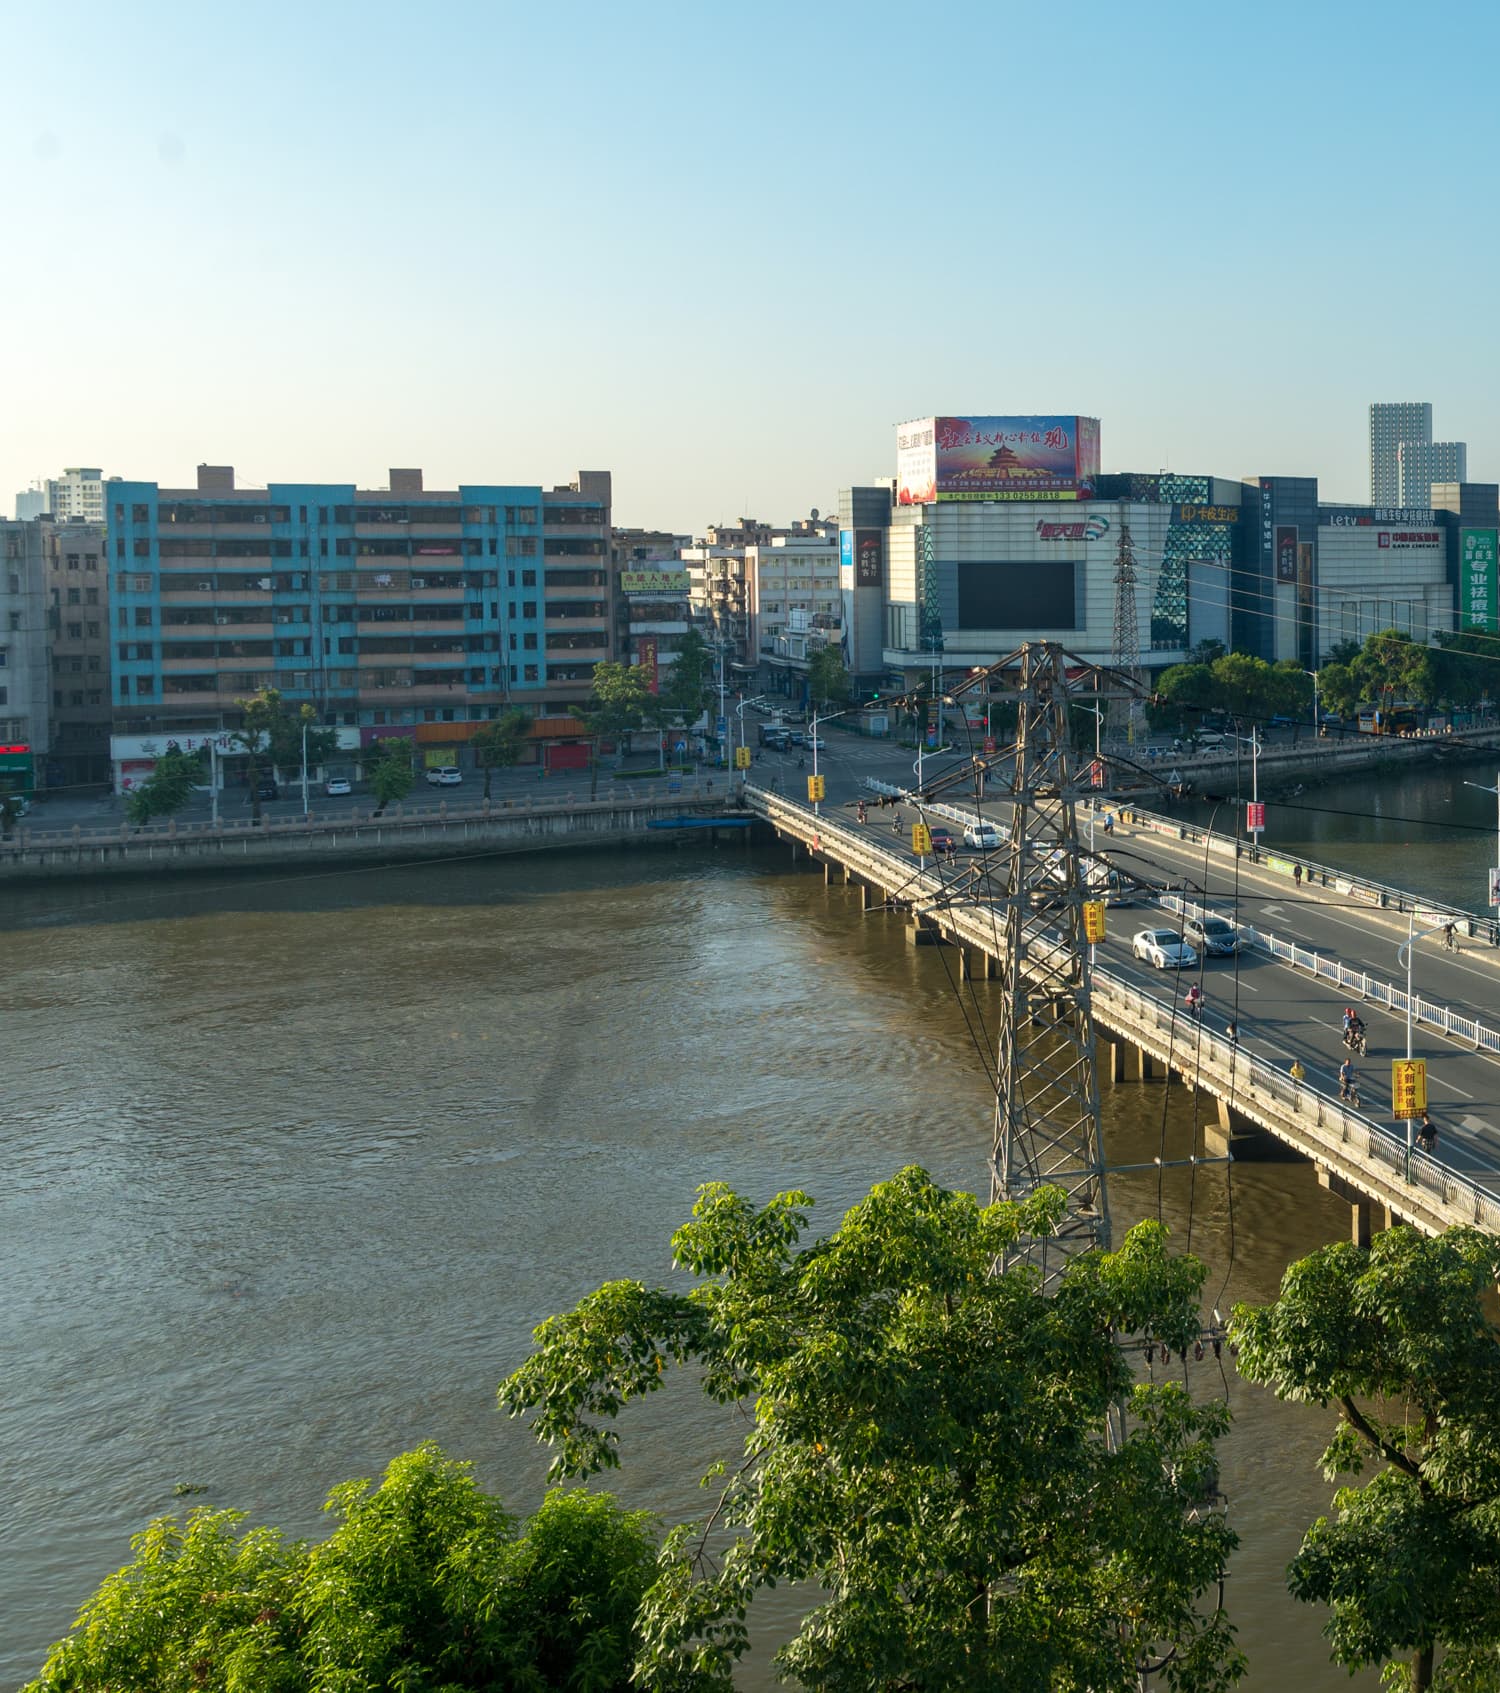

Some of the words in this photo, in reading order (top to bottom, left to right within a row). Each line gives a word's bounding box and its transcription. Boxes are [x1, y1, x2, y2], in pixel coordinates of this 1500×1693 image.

[939, 425, 1068, 451] 社会主义核心价值观
[1330, 515, 1357, 526] Letv
